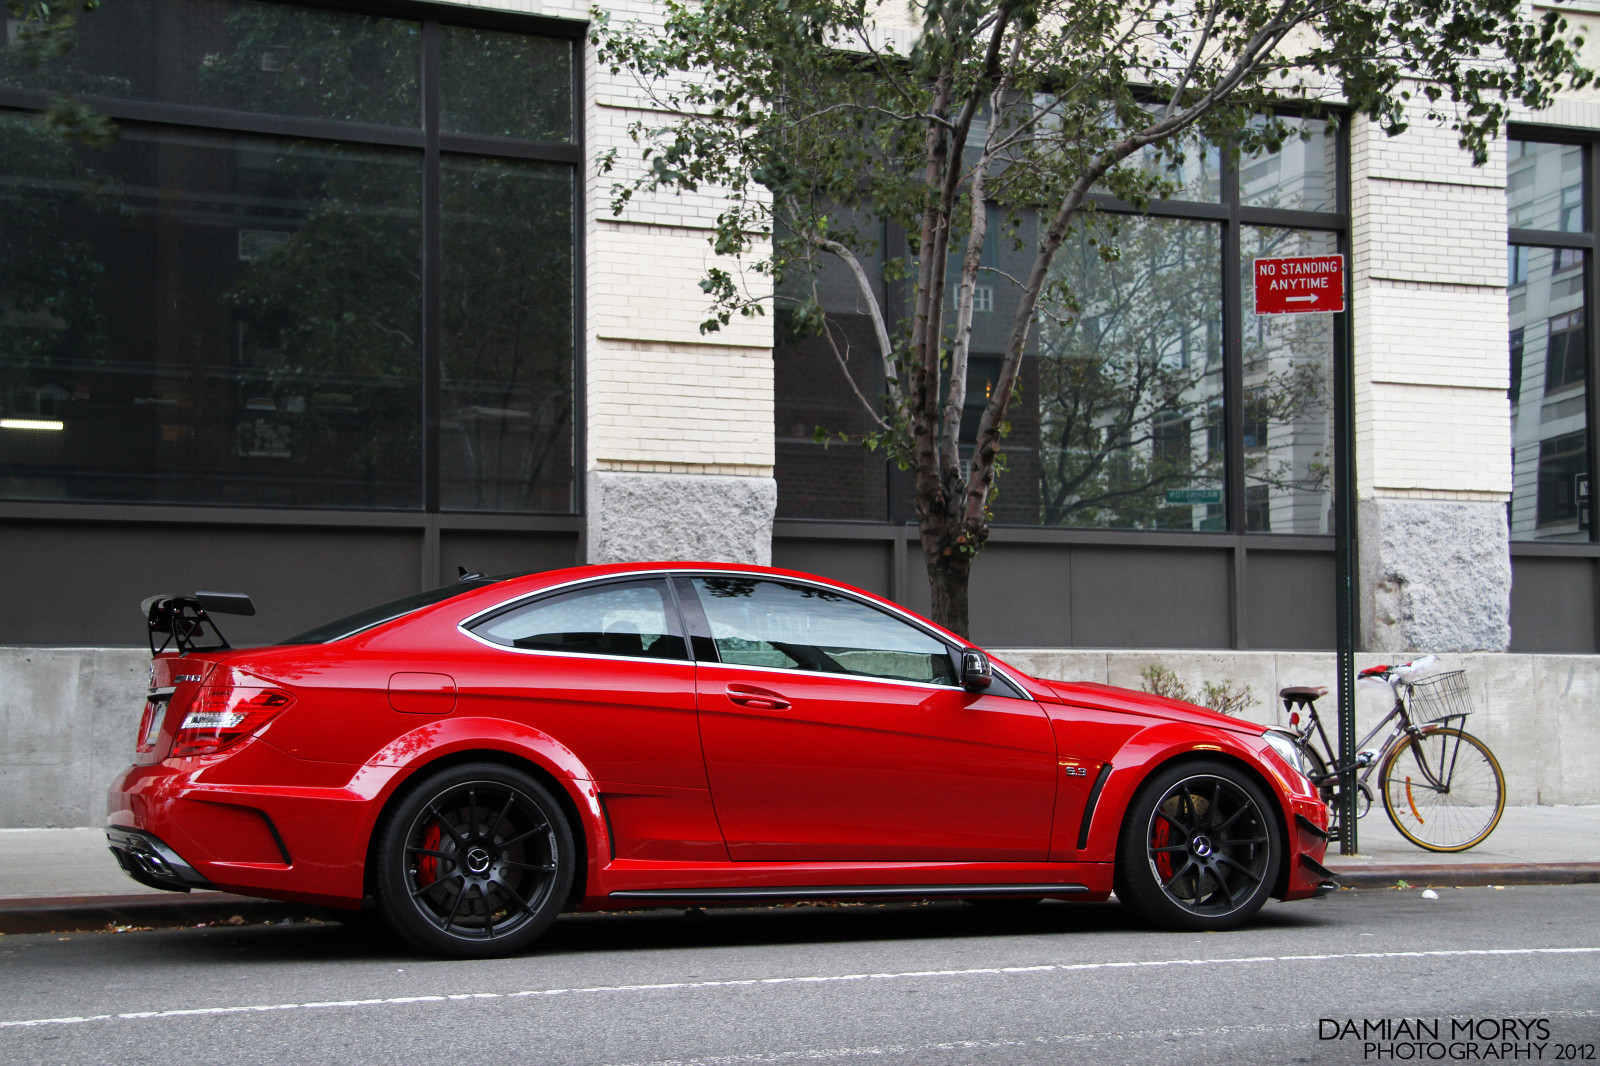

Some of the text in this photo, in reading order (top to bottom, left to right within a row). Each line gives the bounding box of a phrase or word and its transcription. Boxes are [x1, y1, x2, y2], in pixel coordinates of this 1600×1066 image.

[1260, 261, 1337, 276] NO STANDING
[1269, 277, 1329, 291] ANYTIME
